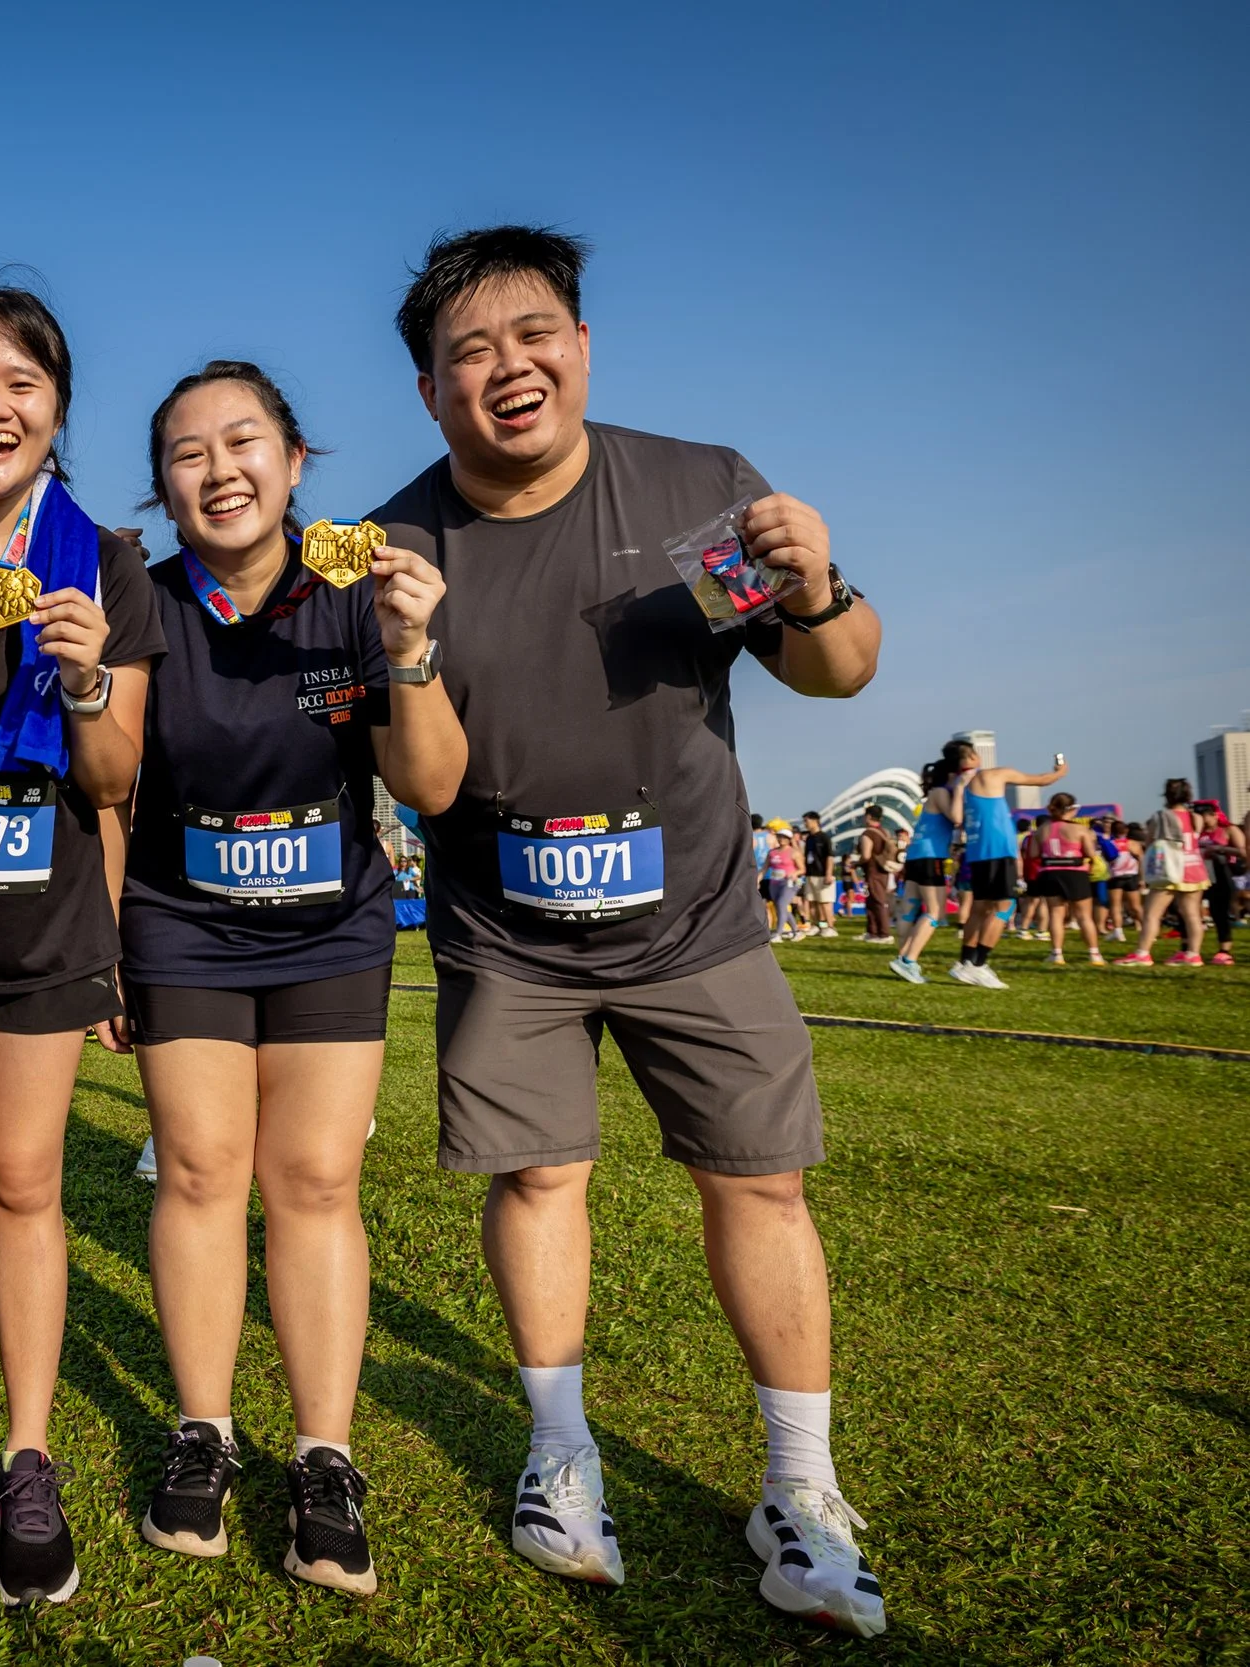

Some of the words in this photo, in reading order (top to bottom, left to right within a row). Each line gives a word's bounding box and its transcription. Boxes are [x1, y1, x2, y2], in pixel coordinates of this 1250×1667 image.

[308, 540, 337, 559] RUN
[336, 570, 348, 578] 10
[303, 666, 353, 685] INSEA
[296, 694, 325, 710] BCG
[330, 710, 351, 725] 2016
[27, 788, 40, 796] 10
[22, 795, 41, 803] km
[307, 808, 321, 816] 10
[625, 812, 640, 821] 10
[200, 815, 224, 827] SG
[304, 815, 323, 824] km
[511, 819, 533, 831] SG
[622, 819, 642, 829] km
[215, 835, 308, 876] 10101
[523, 841, 632, 886] 10071
[239, 876, 286, 886] CARISSA
[555, 889, 585, 900] Ryan
[588, 887, 604, 898] Ng
